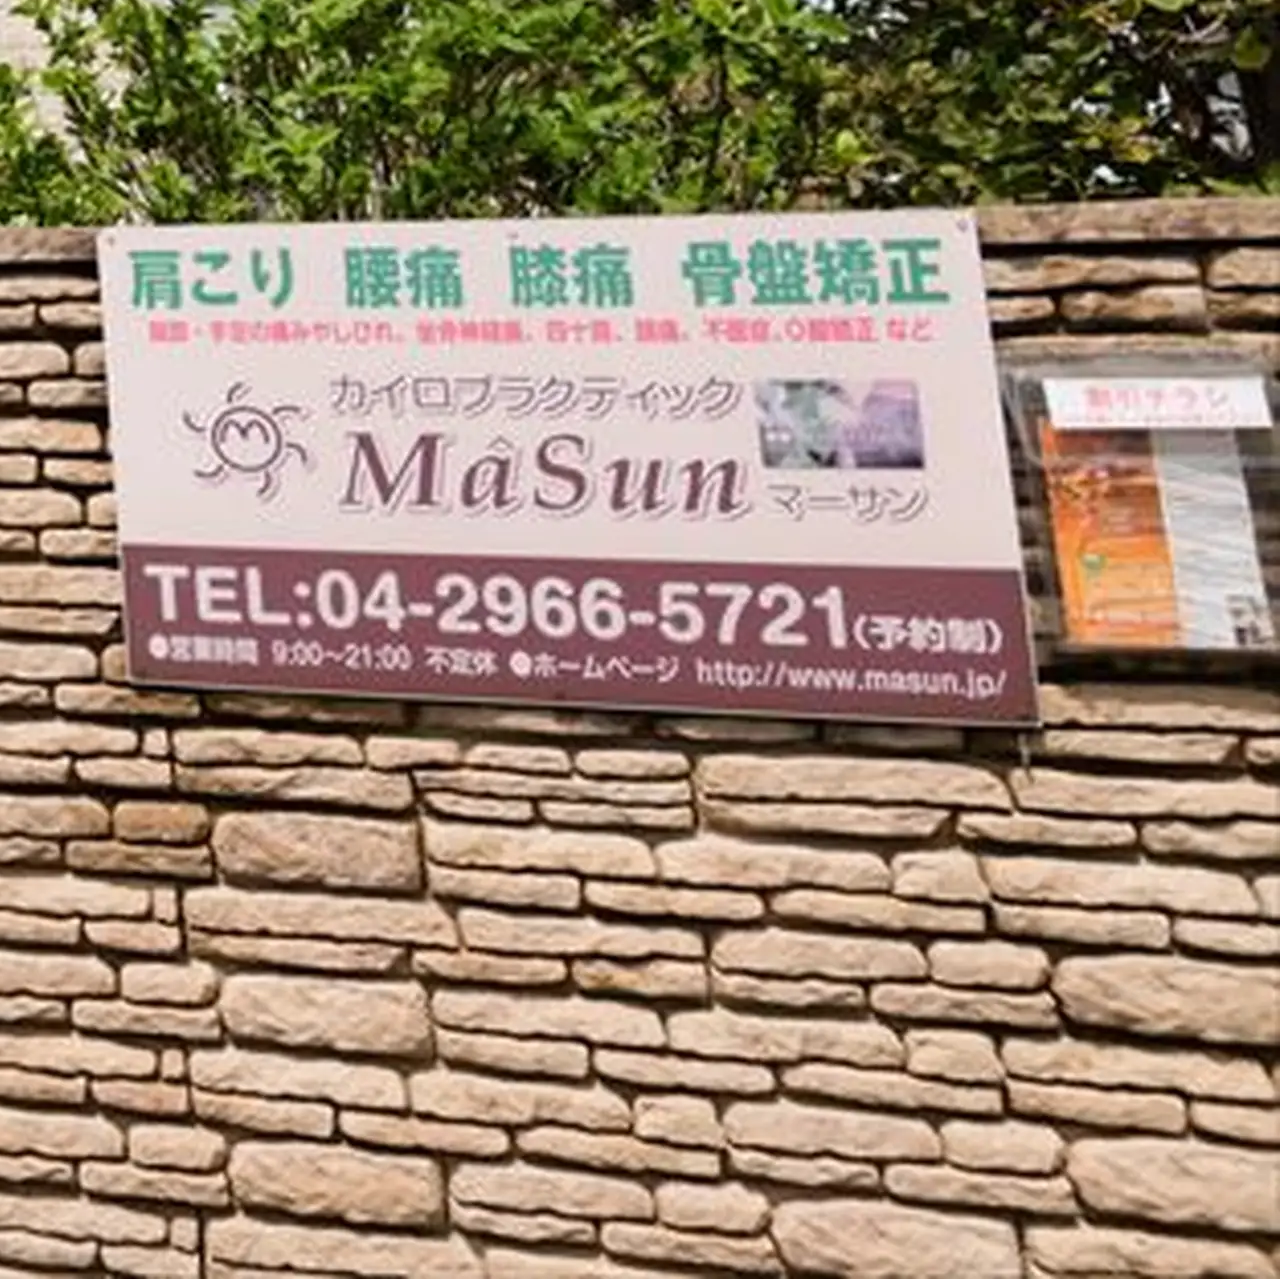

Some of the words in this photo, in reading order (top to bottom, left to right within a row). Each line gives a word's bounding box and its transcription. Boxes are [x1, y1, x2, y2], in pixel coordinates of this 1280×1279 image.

[127, 247, 295, 308] 肩こり
[344, 244, 464, 308] 腰痛
[509, 242, 634, 308] 膝痛
[681, 238, 950, 307] 骨盤矯正
[765, 482, 929, 524] マーサン
[696, 657, 1007, 699] http://www.masun.jp/
